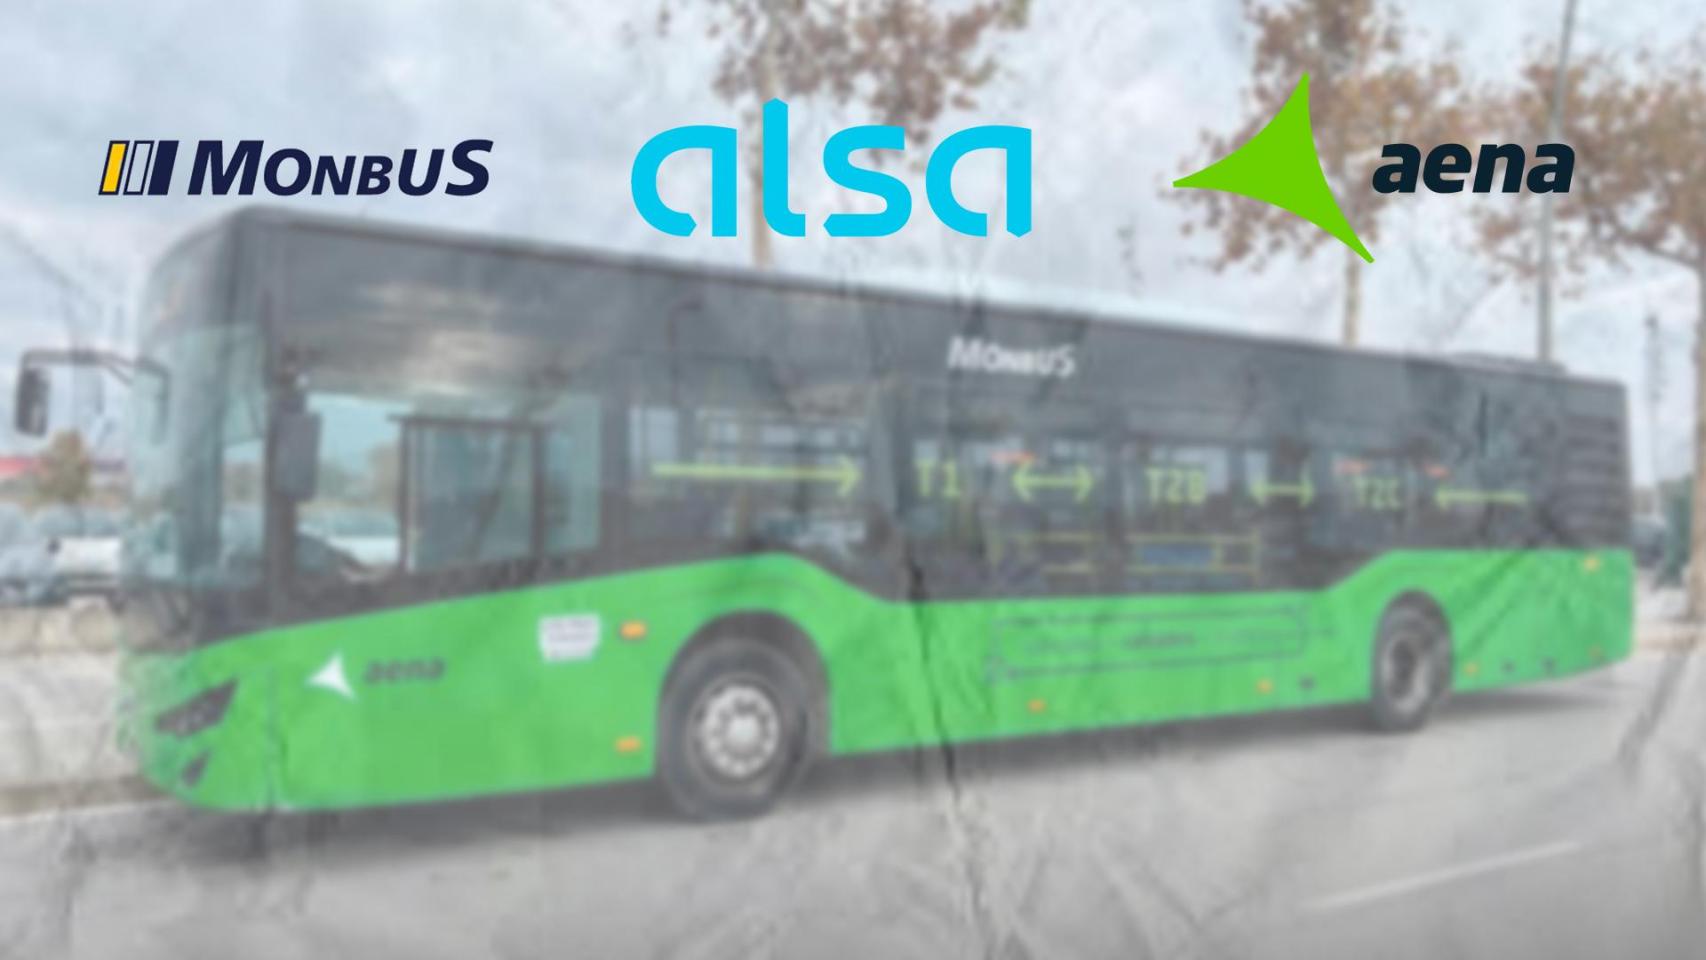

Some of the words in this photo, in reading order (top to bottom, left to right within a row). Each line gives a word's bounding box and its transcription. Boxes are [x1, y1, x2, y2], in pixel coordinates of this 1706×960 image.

[915, 460, 962, 498] T1
[1145, 466, 1206, 504] T2B
[364, 659, 446, 685] aena
